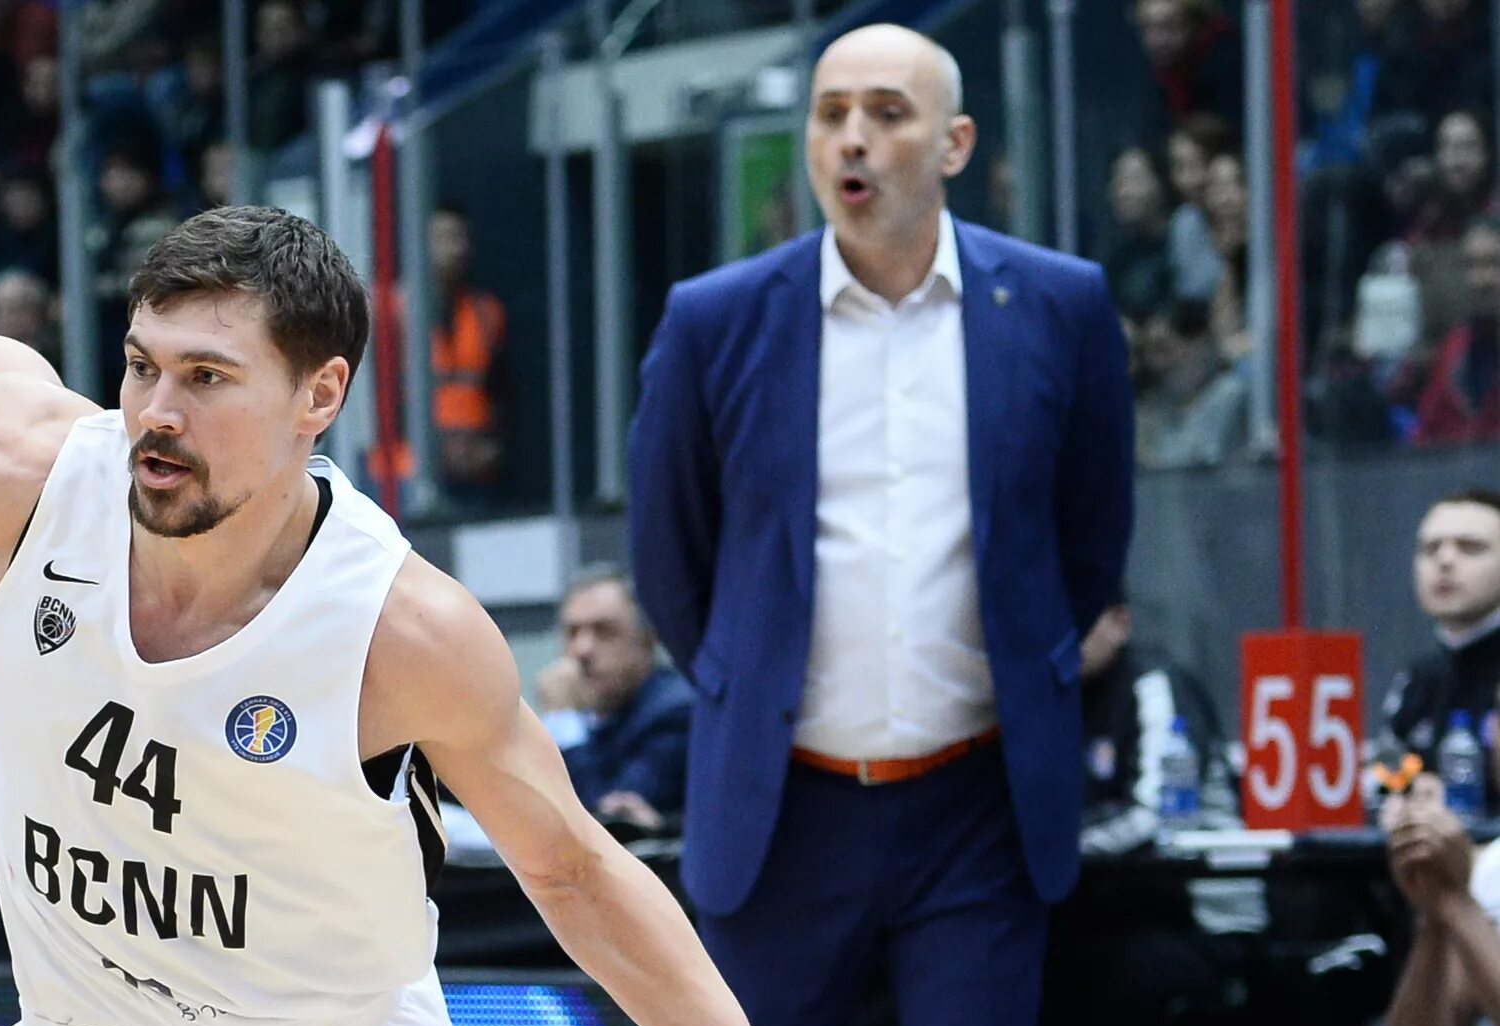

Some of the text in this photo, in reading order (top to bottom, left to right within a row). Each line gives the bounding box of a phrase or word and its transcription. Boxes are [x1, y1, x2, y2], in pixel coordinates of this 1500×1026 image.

[39, 595, 76, 628] BCNN
[64, 700, 181, 834] 44
[1248, 675, 1357, 808] 55
[24, 815, 248, 949] BCNN
